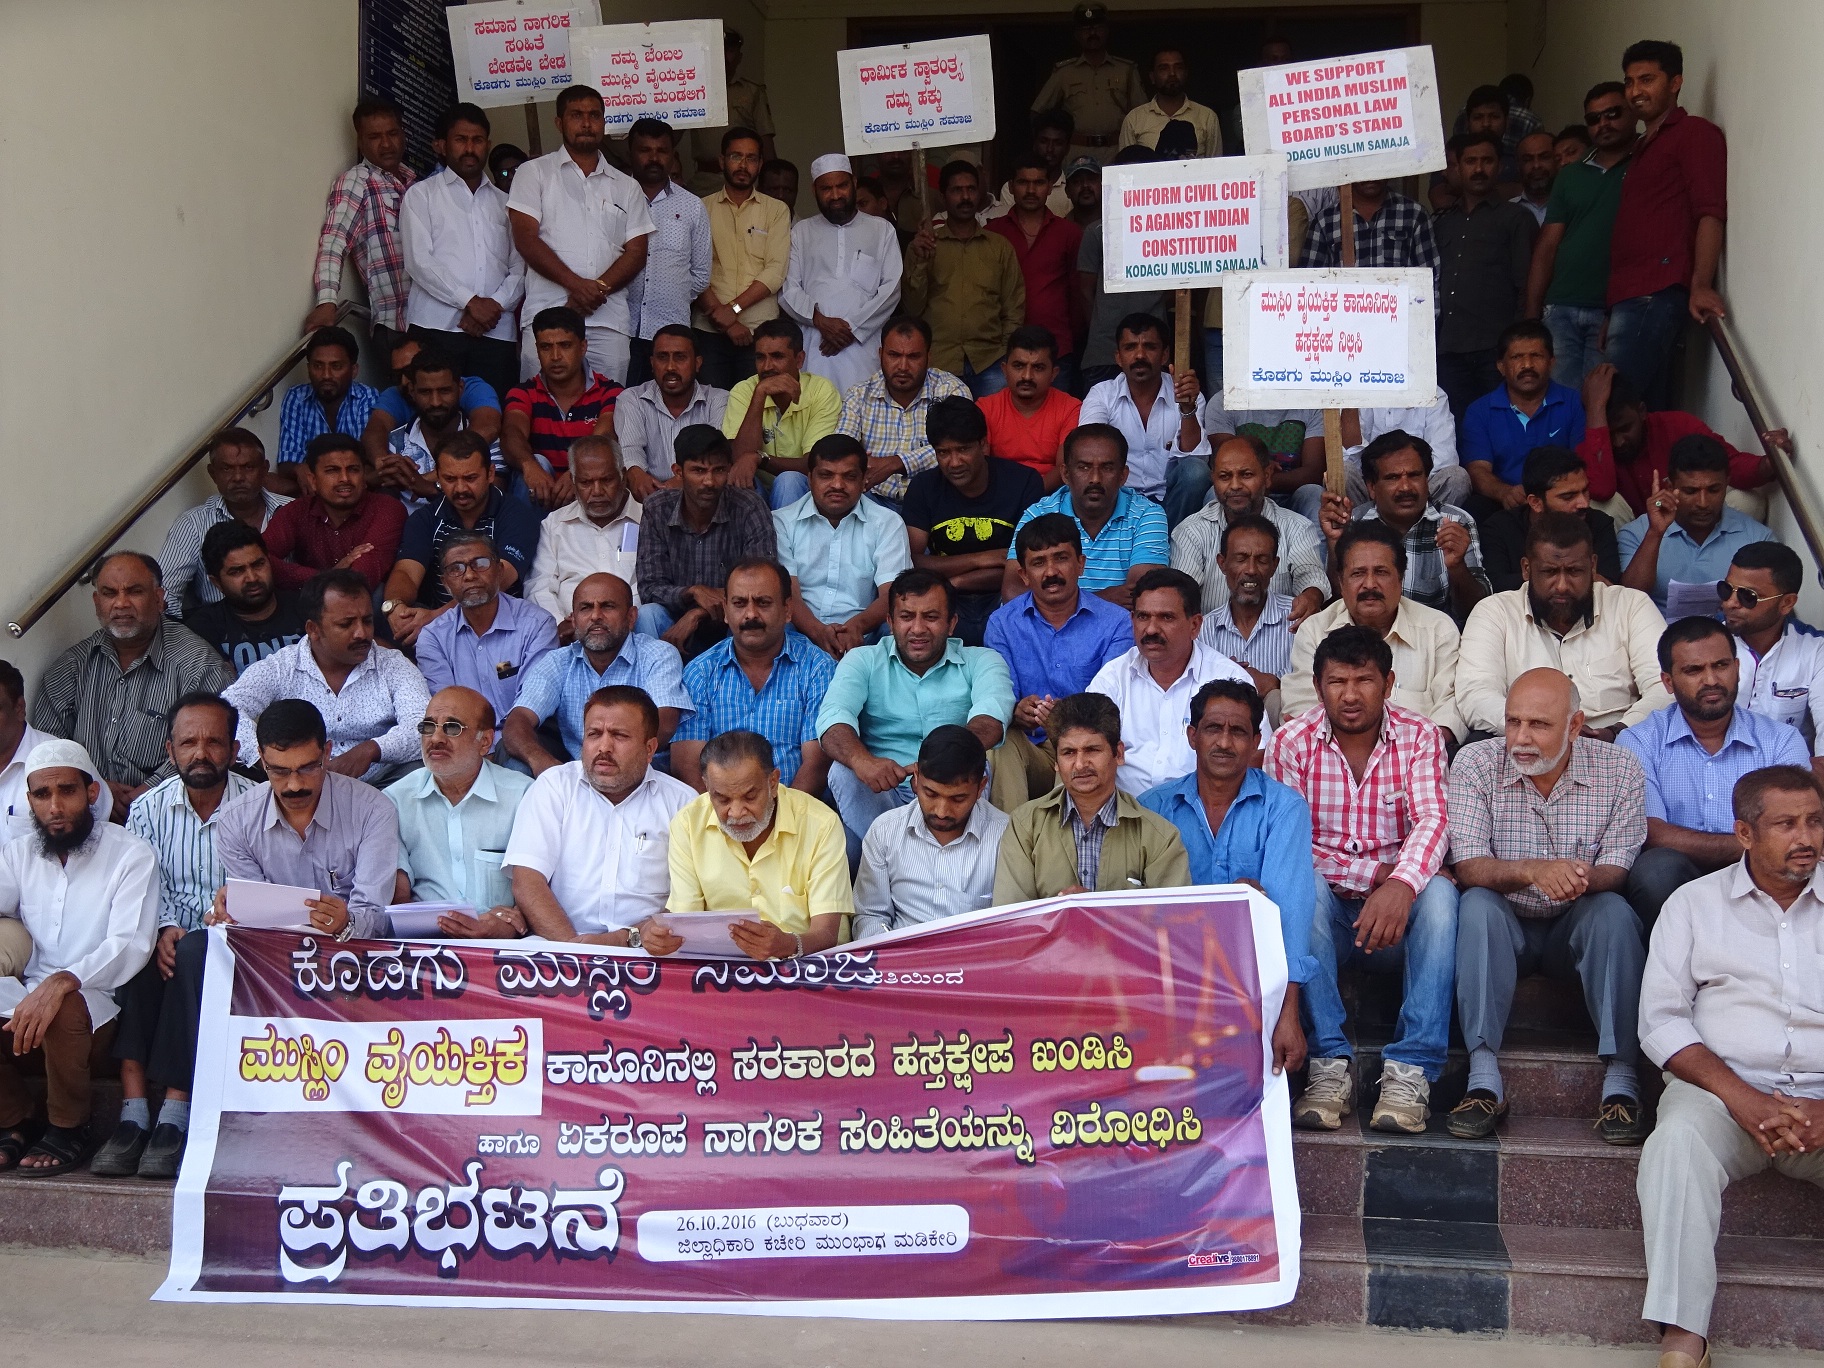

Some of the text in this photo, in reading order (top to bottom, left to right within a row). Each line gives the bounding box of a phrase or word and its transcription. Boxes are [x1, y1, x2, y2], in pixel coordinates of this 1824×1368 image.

[474, 11, 571, 35] ಸಮಾನ ನಾಗರಿಕ
[505, 34, 544, 53] ಸಂಹಿತೆ
[488, 53, 566, 74] ಬೇಡವೇ ಬೇಡ
[611, 47, 683, 69] ನಮ್ಮ ಬೆಂಬಲ
[859, 53, 965, 85] ಧಾರ್ಮಿಕ ಸ್ವಾತಂತ್ರ್ಯ
[474, 79, 510, 91] ಕೊಡಗು
[516, 76, 546, 89] ಮುಸ್ಲಿಂ
[601, 66, 696, 90] ಮುಸ್ಲಿಂ ವೈಯಕ್ತಿಕ
[1285, 60, 1385, 86] WE SUPPORT
[885, 85, 943, 115] ನಮ್ಮ ಹಕ್ಕು
[1269, 76, 1407, 108] ALL INDIA MUSLIM
[673, 107, 706, 119] ಸಮಾಜ
[864, 114, 973, 134] ಕೊಡಗು ಮುಸ್ಲಿಂ ಸಮಾಜ
[1282, 97, 1398, 125] PERSONAL LAW
[1282, 115, 1403, 144] BOARD'S STAND
[1287, 136, 1410, 162] ODAGU MUSLIM SAMAJA
[1123, 180, 1256, 208] UNIFORM CIVIL CODE
[1130, 207, 1249, 233] IS AGAINST INDIAN
[1142, 234, 1237, 258] CONSTITUTION
[1125, 257, 1259, 278] KODAGU MUSLIM SAMAJA
[1261, 285, 1398, 324] ಮುಸ್ಲಿಂ ವೈಯಕ್ತಿಕ ಕಾನೂನಿನಲ್ಲಿ
[1295, 326, 1363, 364] ಹಸ್ತಕ್ಷೇಪ ನಿಲ್ಲಿಸಿ
[1252, 367, 1405, 387] ಕೊಡಗು ಮುಸ್ಲಿಂ ಸಮಾಜ
[292, 936, 466, 993] ಕೊಡಗು
[499, 949, 658, 1013] ಮುಸ್ಲಿಂ
[239, 1023, 1133, 1108] ಮುಸ್ಲಿಂ ವೈಯಕ್ತಿಕ ಕಾನೂನಿನಲ್ಲಿ ಸರಕಾರದ ಹಸ್ತಕ್ಷೇಪ ಖಂಡಿಸಿ
[478, 1101, 1203, 1163] ಹಾಗೂ ಏಕರೂಪ ನಾಗರಿಕ ಸಂಹಿತೆಯನ್ನು ವಿರೋಧಿಸಿ
[278, 1161, 624, 1283] ಪ್ರತಿಭಟನೆ
[677, 1211, 849, 1233] 26.10.2016 (ಬುಧವಾರ)
[678, 1231, 958, 1261] ಜಿಲ್ಲಾಧಿಕಾರಿ ಕಚೇರಿ ಮುಂಭಾಗ ಮಡಿಕೇರಿ
[1188, 1252, 1230, 1265] Creative
